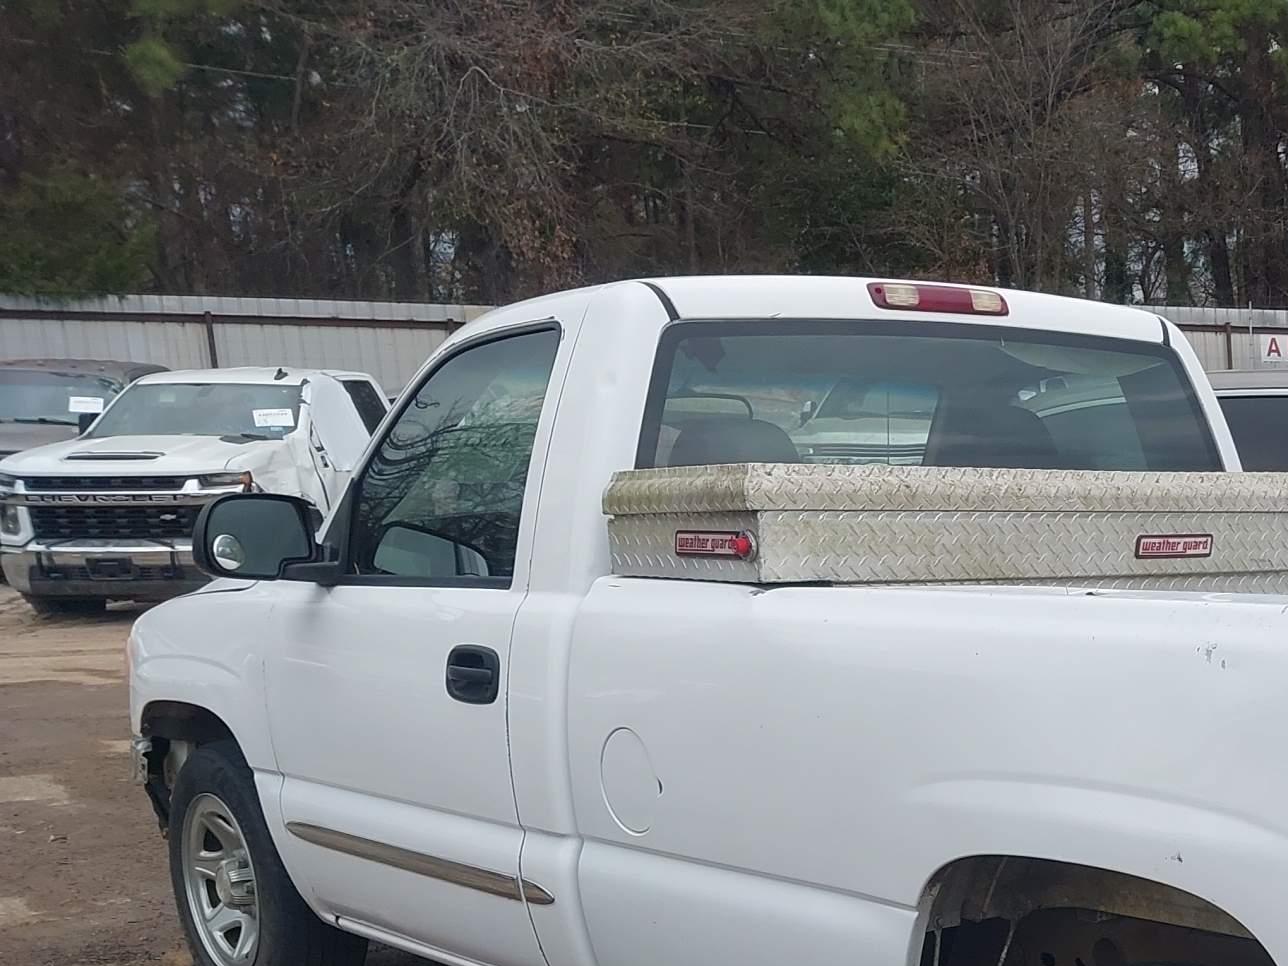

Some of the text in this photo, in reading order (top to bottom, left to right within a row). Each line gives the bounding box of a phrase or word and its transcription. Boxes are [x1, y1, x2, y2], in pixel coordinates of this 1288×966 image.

[1267, 337, 1281, 357] A
[678, 536, 709, 548] weather
[1142, 539, 1209, 553] weather guard
